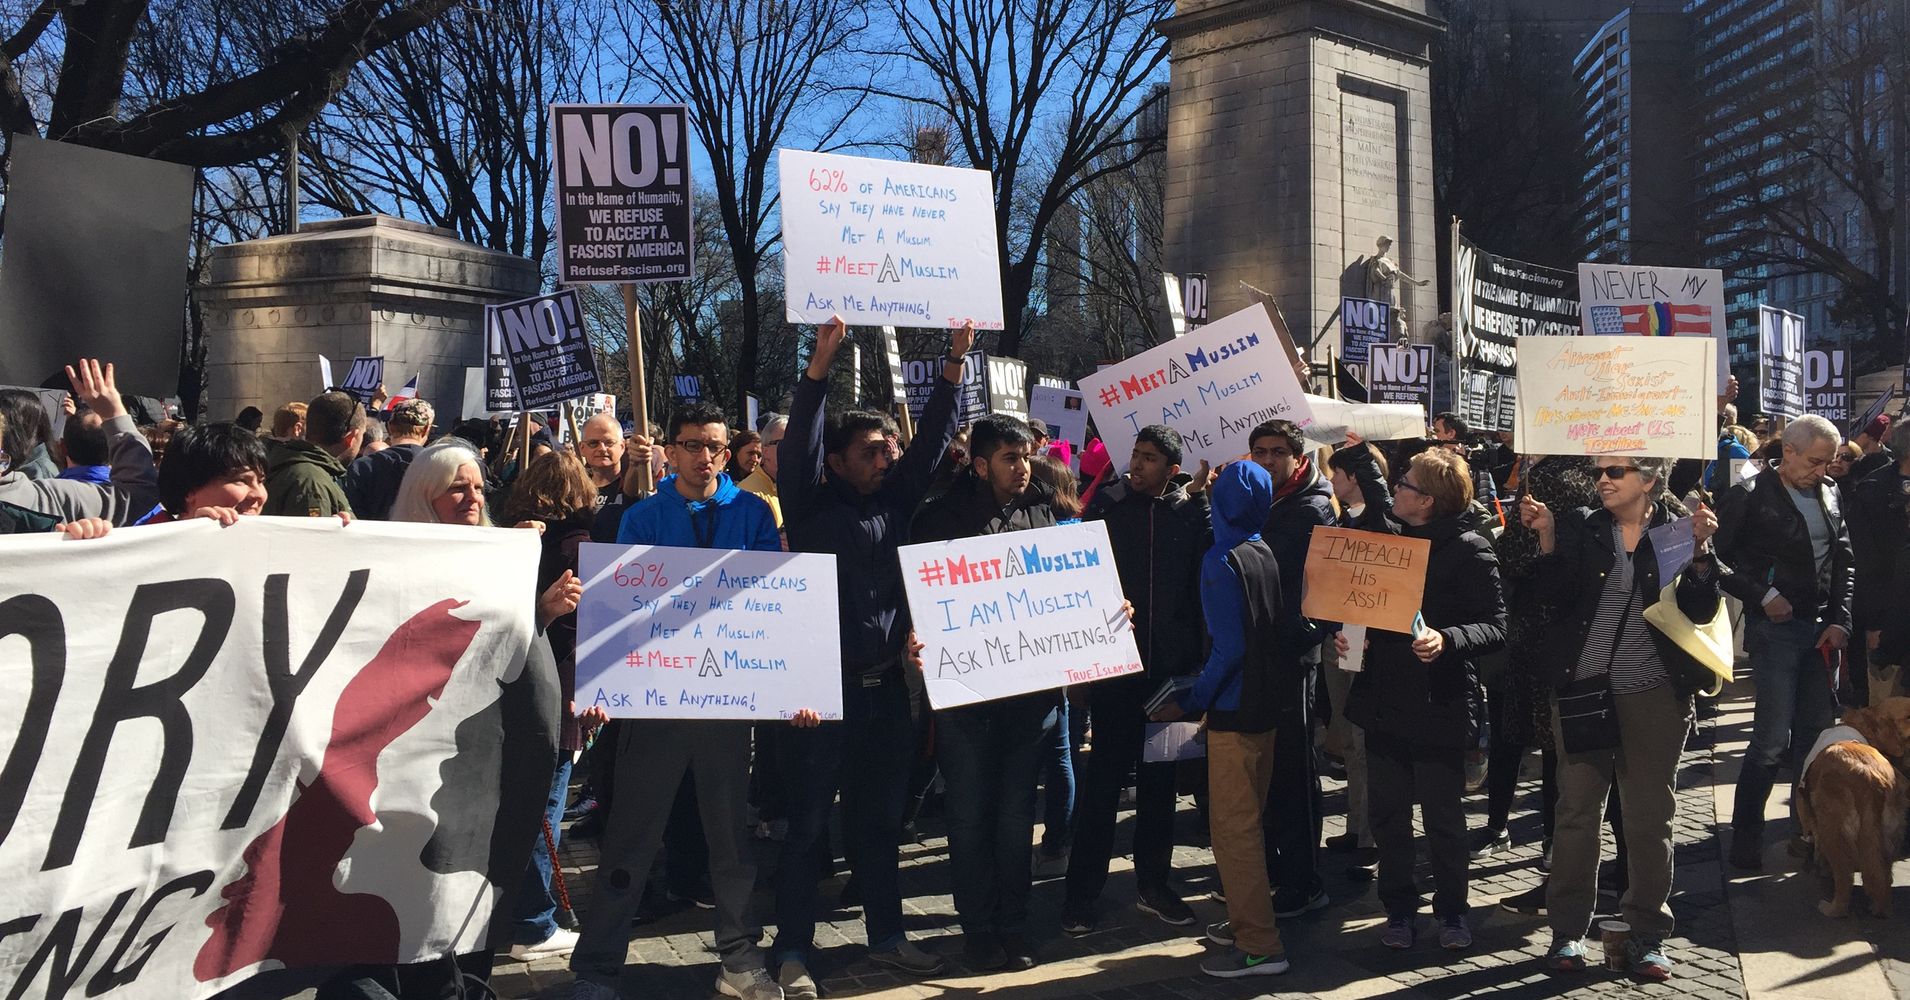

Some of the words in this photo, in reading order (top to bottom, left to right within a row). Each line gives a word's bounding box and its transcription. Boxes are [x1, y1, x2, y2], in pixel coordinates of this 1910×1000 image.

[562, 112, 681, 188] NO!
[809, 168, 848, 193] 62%
[859, 183, 873, 195] OF
[883, 177, 957, 202] AMERICANS
[566, 192, 575, 206] In
[578, 192, 594, 206] the
[597, 192, 624, 206] Name
[627, 191, 636, 205] of
[638, 191, 683, 207] Humanity,
[819, 201, 841, 218] SAY
[849, 201, 875, 222] THEY
[882, 204, 904, 216] HAVE
[912, 206, 946, 221] NEVER
[589, 209, 611, 224] WE
[614, 208, 664, 224] REFUSE
[584, 227, 603, 242] TO
[606, 226, 657, 241] ACCEPT
[660, 225, 669, 239] A
[841, 226, 866, 245] MET
[876, 227, 885, 244] A
[569, 244, 624, 259] FASCIST
[627, 241, 685, 258] AMERICA
[570, 263, 685, 276] RefuseFascism.org
[1591, 270, 1669, 300] NEVER
[1681, 275, 1707, 299] MY
[806, 292, 836, 311] ASK
[843, 295, 865, 311] ME
[870, 295, 931, 320] ANYTHING!
[1520, 291, 1533, 309] OF
[501, 295, 582, 354] NO!
[1346, 300, 1386, 332] NO!
[1474, 304, 1485, 331] WE
[1485, 309, 1519, 339] REFUSE
[1763, 310, 1801, 363] NO!
[345, 359, 383, 389] NO!
[529, 361, 545, 373] WE
[545, 353, 576, 370] REFUSE
[529, 373, 541, 384] TO
[543, 365, 575, 381] ACCEPT
[575, 362, 582, 373] A
[964, 354, 982, 385] O!
[1373, 347, 1429, 384] NO!
[1805, 350, 1844, 388] O!
[499, 378, 510, 388] TO
[522, 380, 557, 397] FASCIST
[558, 370, 595, 388] AMERICA
[674, 375, 701, 397] NO!
[988, 360, 1027, 398] NO!
[1768, 378, 1777, 389] TO
[525, 383, 598, 407] RefuseFascism.org
[1123, 410, 1140, 437] I
[1162, 398, 1191, 424] AM
[1197, 371, 1263, 406] MUSLIM
[1383, 392, 1394, 400] WE
[1395, 392, 1419, 400] REFUSE
[1816, 392, 1847, 407] OUT
[1182, 429, 1213, 454] ME
[1219, 396, 1292, 439] ANYTHING!
[1604, 421, 1644, 436] about
[596, 494, 608, 505] O!
[1322, 535, 1413, 568] IMPEACH
[614, 562, 669, 588] 62%
[682, 575, 703, 589] OF
[716, 568, 808, 592] AMERICANS
[631, 596, 659, 614] SAY
[670, 594, 697, 617] THEY
[709, 596, 734, 611] HAVE
[745, 599, 784, 615] NEVER
[936, 598, 961, 632] I
[969, 601, 1003, 628] AM
[1006, 588, 1093, 621] MUSLIM
[1343, 591, 1388, 609] ASS!!
[650, 622, 681, 640] MET
[693, 623, 703, 639] A
[937, 646, 983, 679] ASK
[984, 635, 1016, 667] ME
[1018, 608, 1117, 661] ANYTHING!
[593, 687, 633, 707] ASK
[645, 688, 669, 707] ME
[679, 688, 756, 713] ANYTHING!
